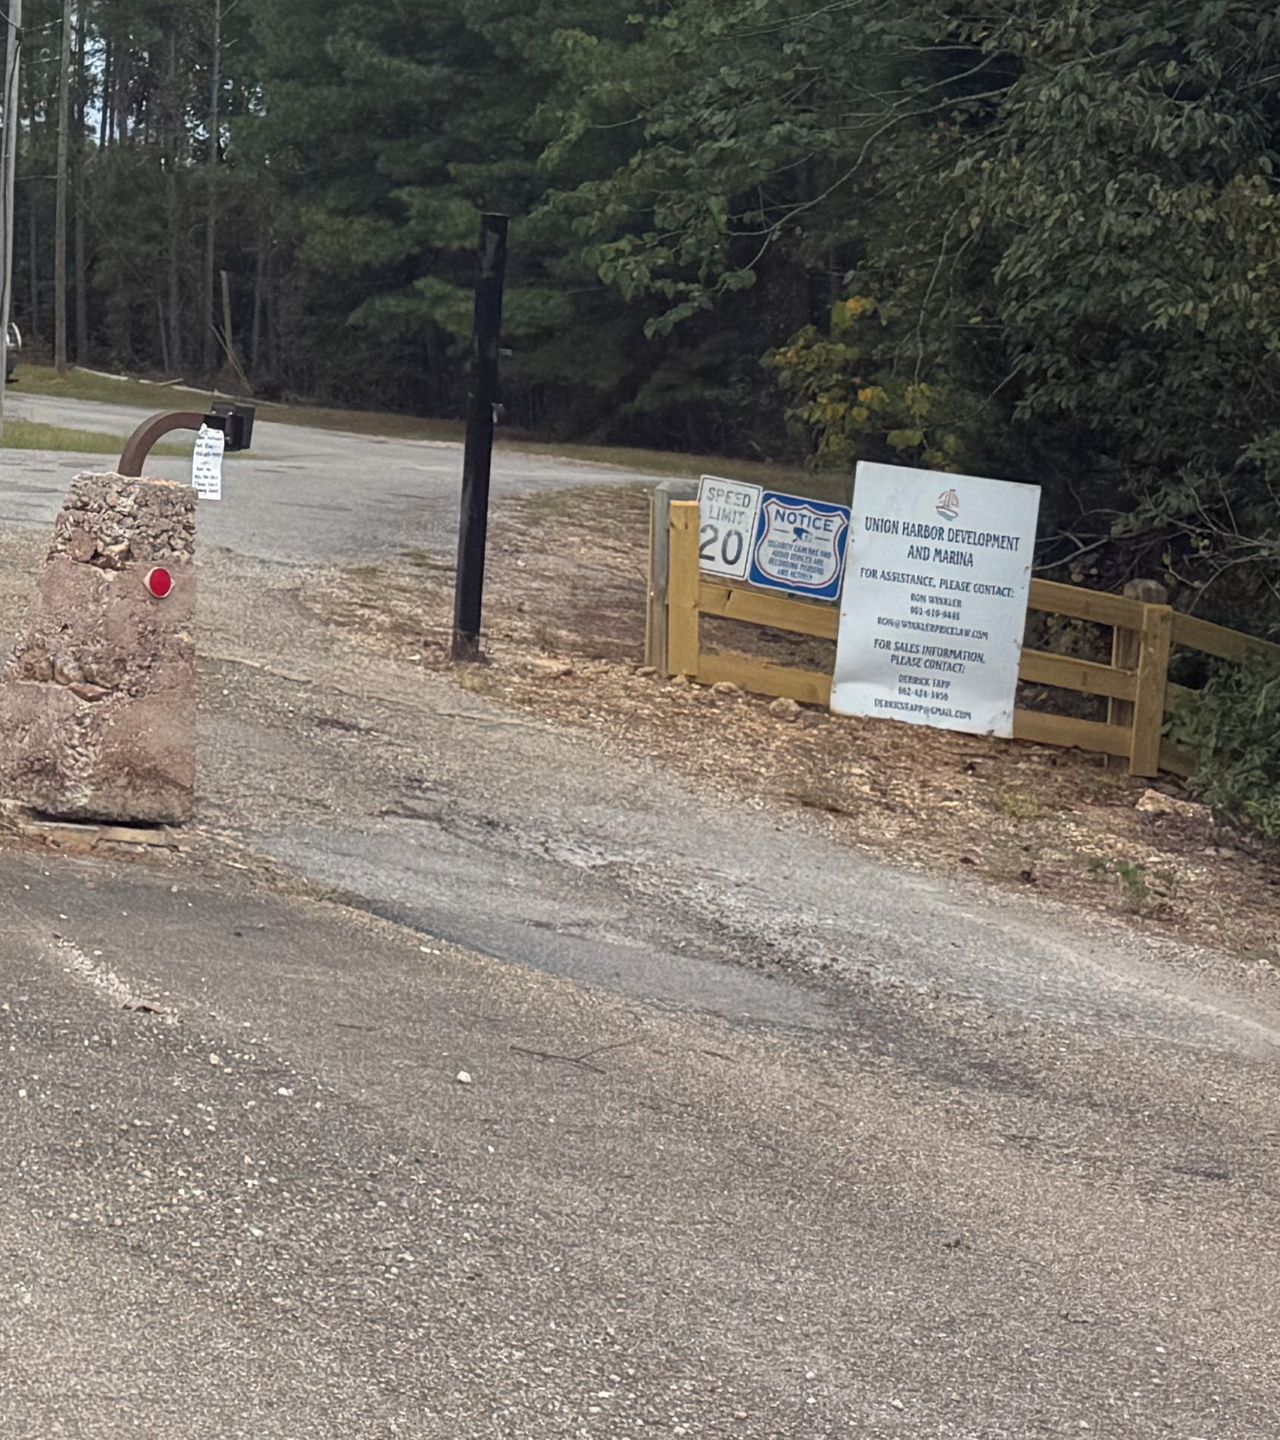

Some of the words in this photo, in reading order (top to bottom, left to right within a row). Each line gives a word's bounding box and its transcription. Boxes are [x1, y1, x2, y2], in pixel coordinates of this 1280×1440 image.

[706, 486, 752, 508] SPEED
[708, 505, 746, 526] LIMIT
[774, 509, 835, 533] NOTICE
[698, 523, 744, 566] 20
[864, 516, 899, 535] UNION
[901, 521, 945, 541] HARBOR
[947, 527, 1020, 552] DEVELOPMENT
[907, 544, 930, 561] AND
[932, 547, 974, 568] MARINA
[860, 567, 878, 580] FOR
[879, 570, 937, 589] ASSISTANCE,
[939, 577, 971, 593] PLEASE
[972, 583, 1016, 598] CONTACT:
[873, 638, 891, 651] FOR
[893, 640, 920, 655] SALES
[890, 653, 921, 668] PLEASE
[923, 658, 966, 674] CONTACT:
